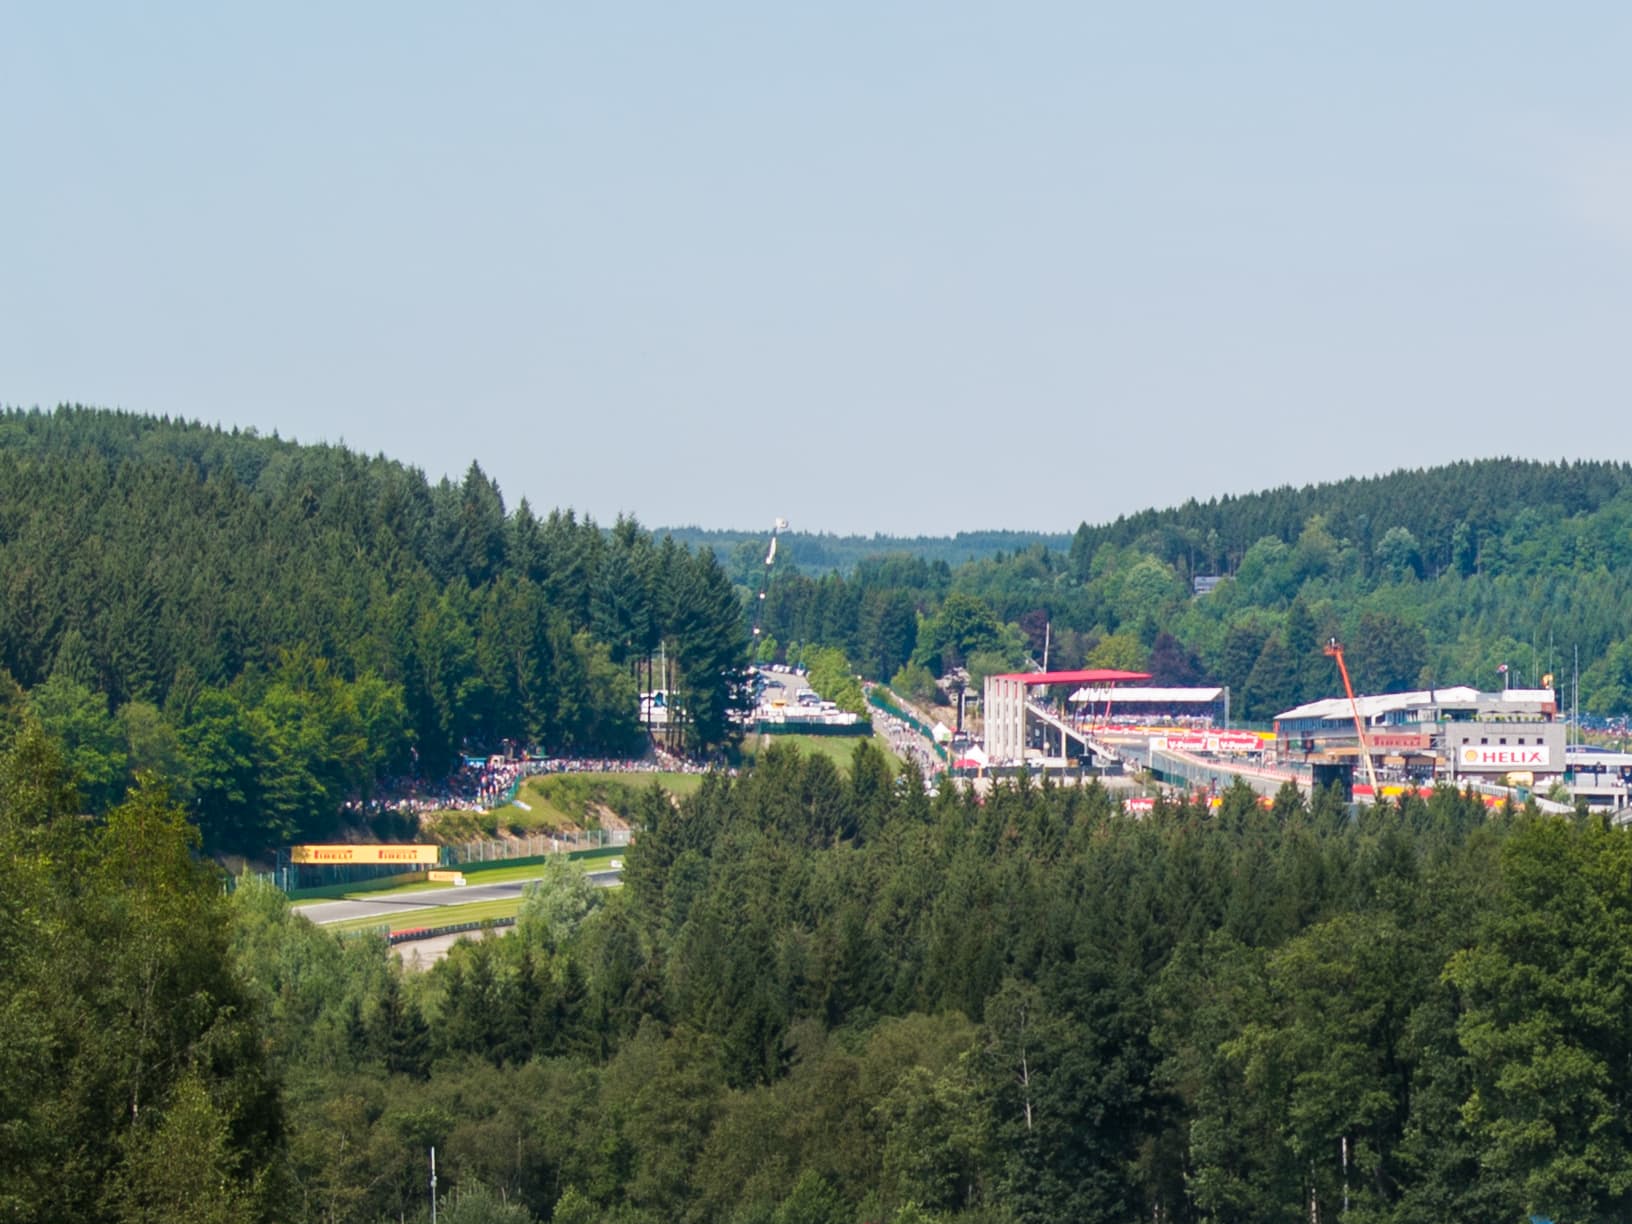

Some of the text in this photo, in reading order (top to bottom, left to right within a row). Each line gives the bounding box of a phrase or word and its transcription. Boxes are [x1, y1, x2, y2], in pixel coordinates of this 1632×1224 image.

[1483, 752, 1542, 763] HELIX
[314, 850, 352, 860] PIRELLI
[378, 850, 417, 860] PIRELLI
